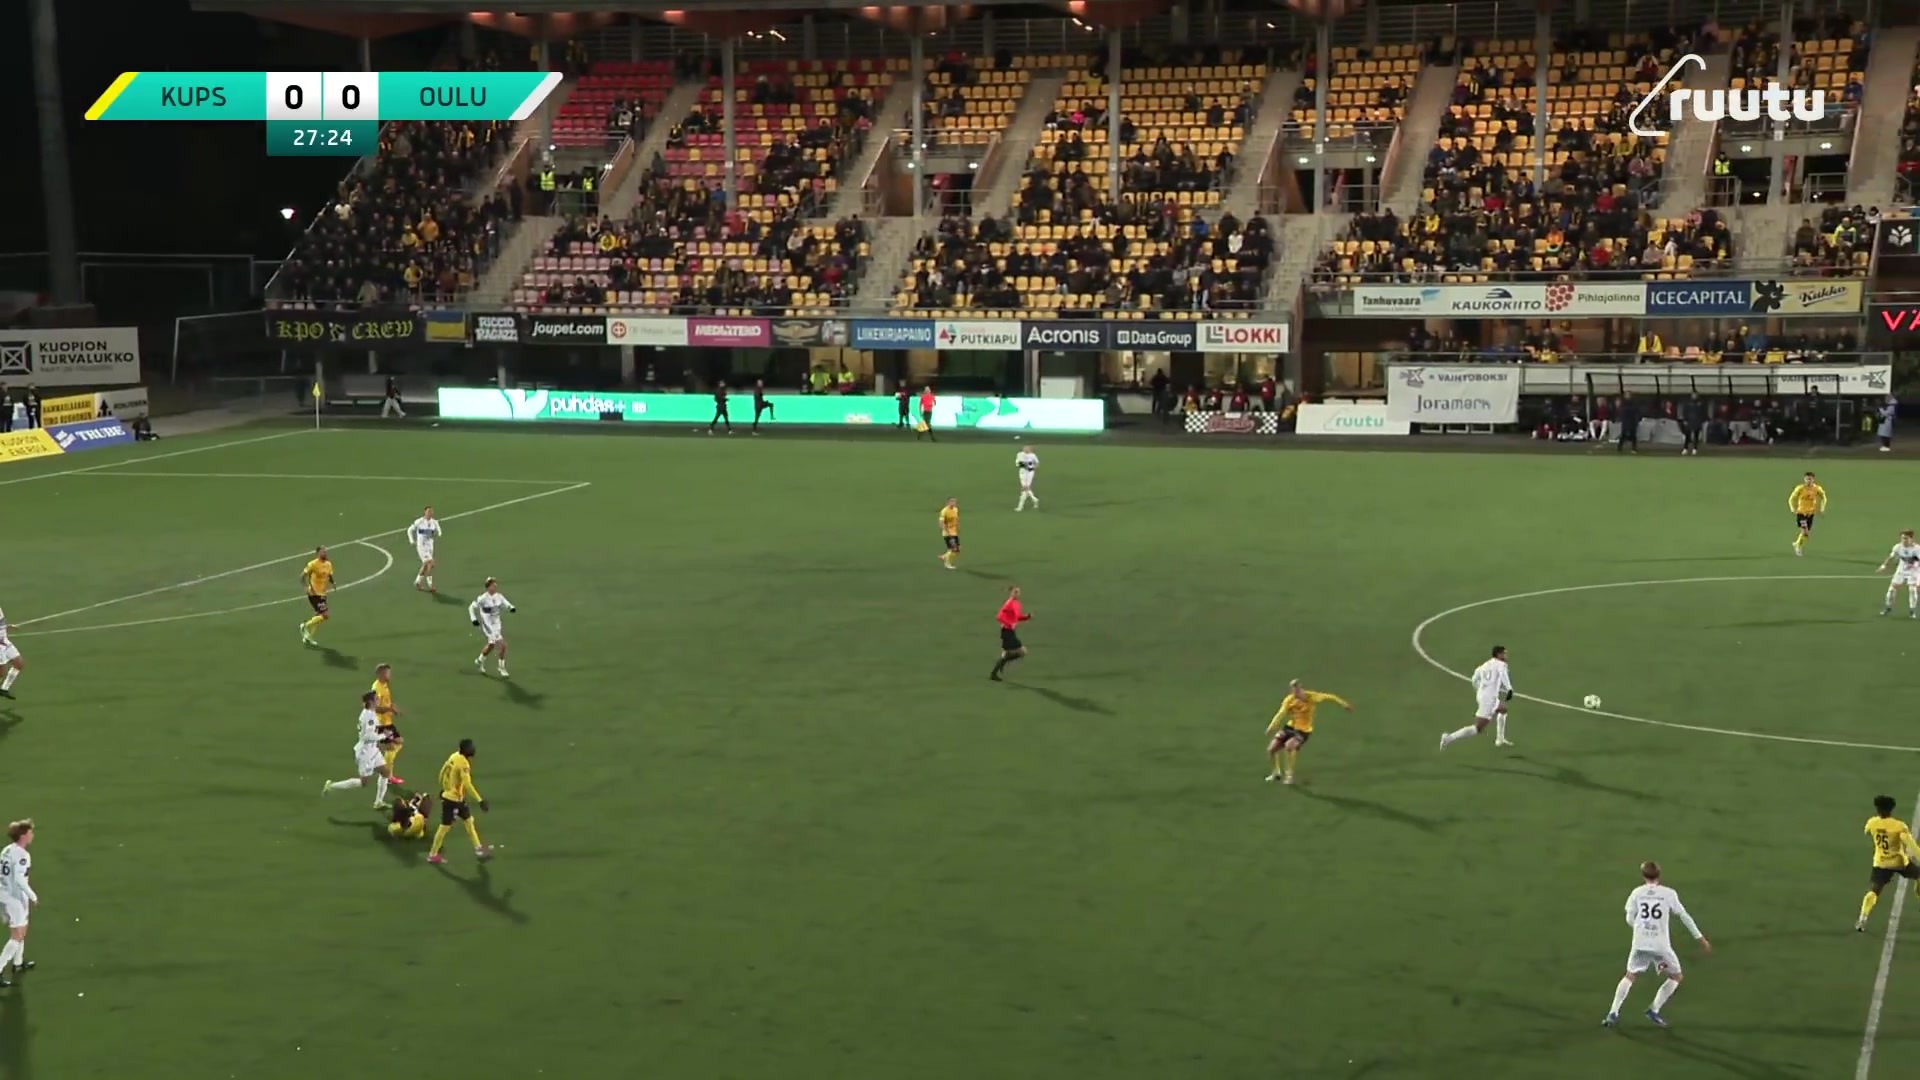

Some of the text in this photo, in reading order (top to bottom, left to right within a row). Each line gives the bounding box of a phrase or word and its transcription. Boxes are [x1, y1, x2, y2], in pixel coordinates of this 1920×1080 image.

[1362, 296, 1421, 306] Tanhuvaara
[1451, 300, 1542, 311] KAUKOKIITO
[1577, 292, 1641, 305] Pihlajalinna
[1650, 291, 1746, 306] ICECAPITAL
[352, 320, 414, 340] CREW
[532, 316, 604, 336] joupet.com
[960, 333, 1018, 345] PUTKIAPU
[1027, 326, 1100, 344] Acronis
[1131, 330, 1191, 347] Data Group
[1225, 328, 1281, 344] LOKKI
[39, 341, 107, 353] KUOPION
[40, 352, 134, 365] TURVALUKKO
[1335, 412, 1384, 428] ruutu
[75, 425, 126, 441] TRUBE
[1875, 833, 1889, 850] 25
[1640, 902, 1662, 919] 36
